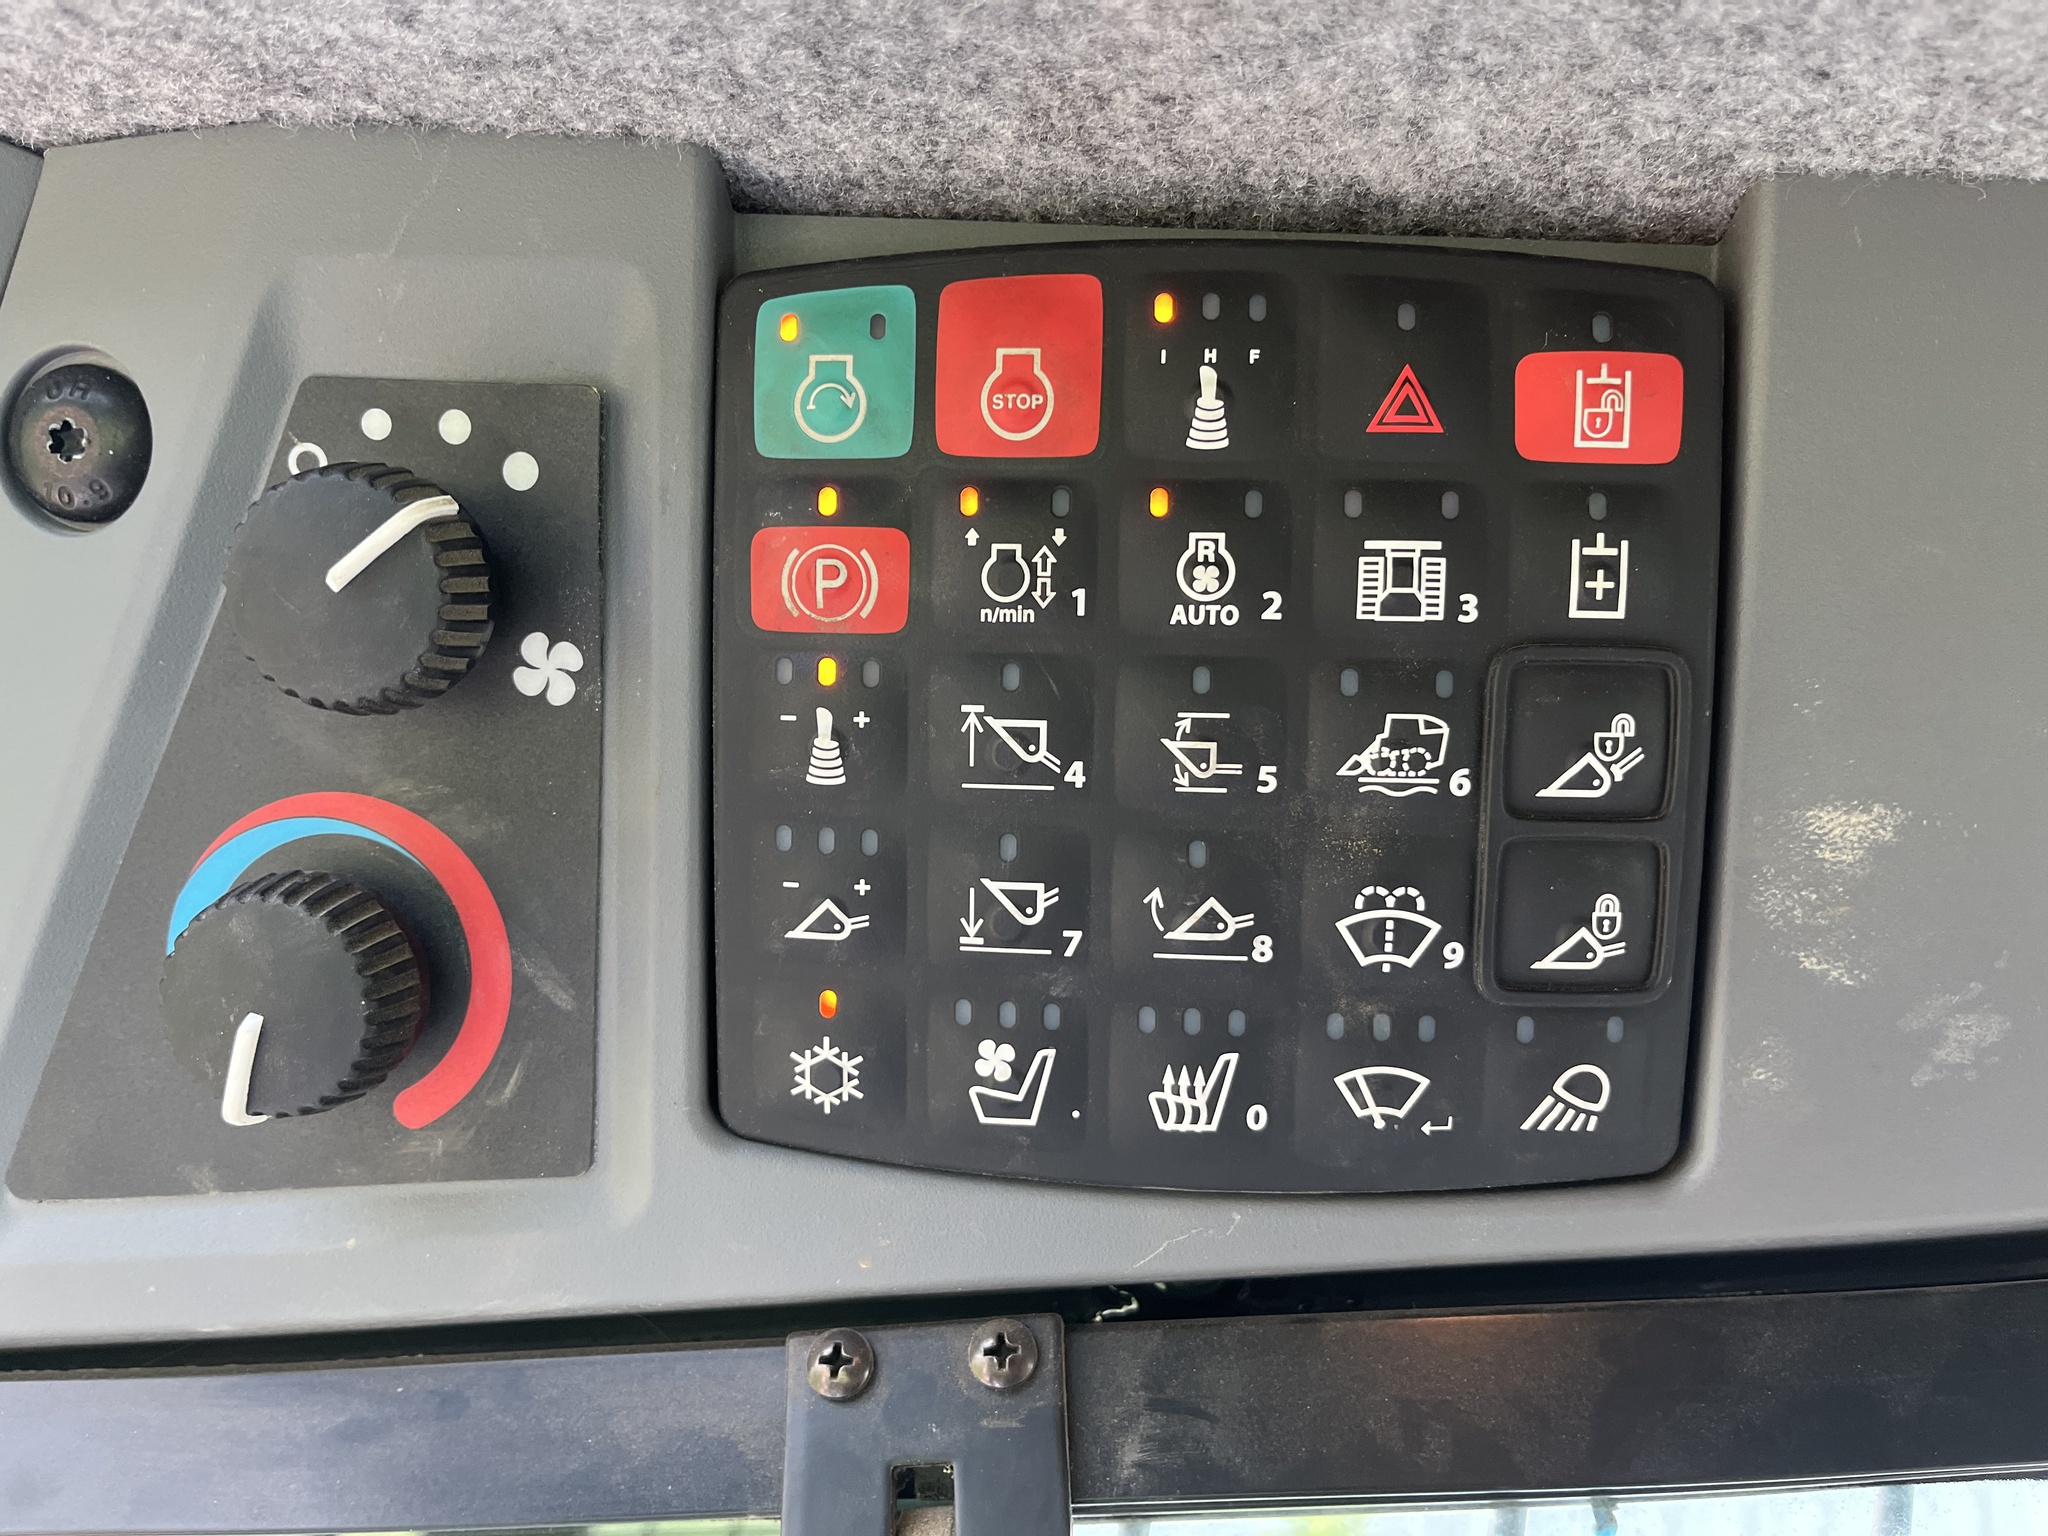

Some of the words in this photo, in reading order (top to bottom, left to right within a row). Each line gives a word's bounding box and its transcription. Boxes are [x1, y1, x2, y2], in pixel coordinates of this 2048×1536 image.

[1204, 349, 1216, 363] H
[1250, 349, 1260, 364] F
[993, 394, 1043, 409] STOP
[1198, 541, 1215, 562] R
[816, 559, 847, 608] P
[981, 605, 1034, 623] n/min
[1072, 589, 1085, 616] 1
[1170, 605, 1239, 625] AUTO
[1261, 591, 1282, 620] 2
[1458, 594, 1478, 623] 3
[1064, 761, 1085, 788] 4
[1257, 766, 1277, 793] 5
[1450, 768, 1471, 796] 6
[1063, 931, 1082, 956] 7
[1252, 935, 1273, 962] 8
[1443, 942, 1464, 969] 9
[1247, 1105, 1267, 1130] 0
